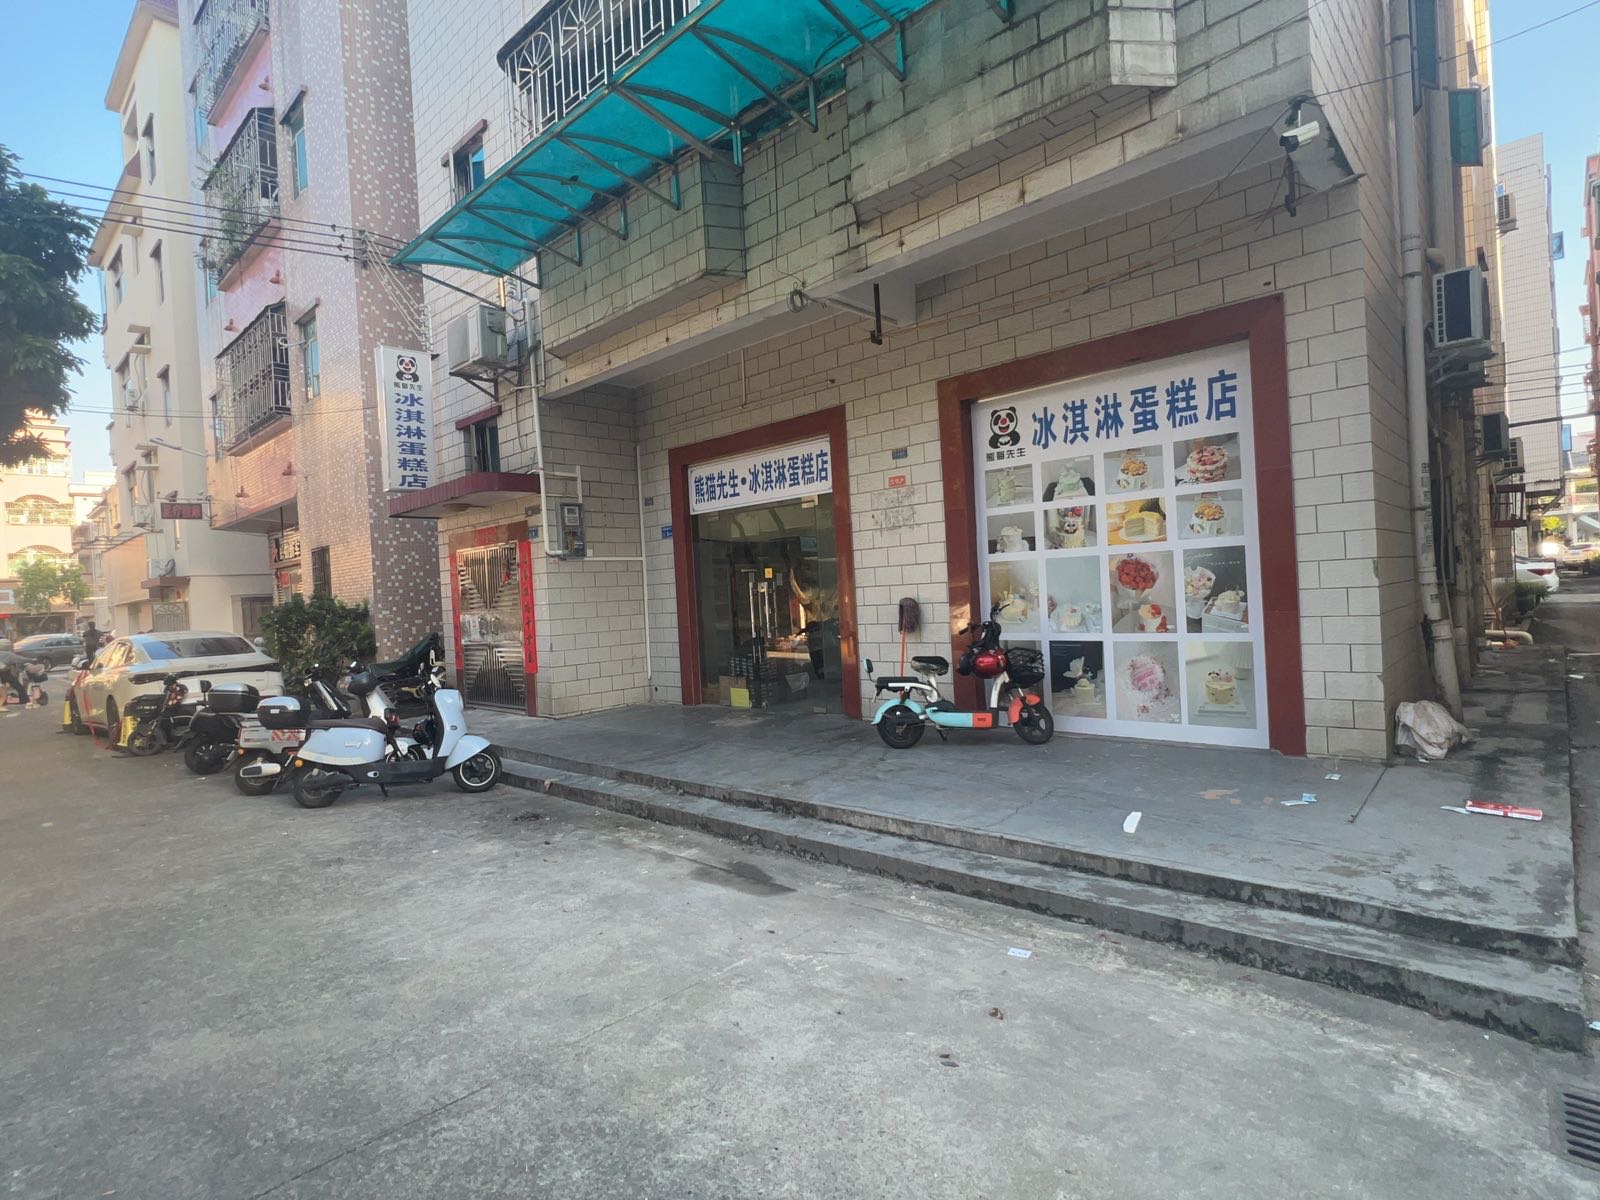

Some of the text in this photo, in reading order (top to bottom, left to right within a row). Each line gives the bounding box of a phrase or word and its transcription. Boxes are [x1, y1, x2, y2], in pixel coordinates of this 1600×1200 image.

[394, 393, 429, 488] 冰淇淋蛋糕店
[1031, 369, 1238, 450] 冰淇淋蛋糕店
